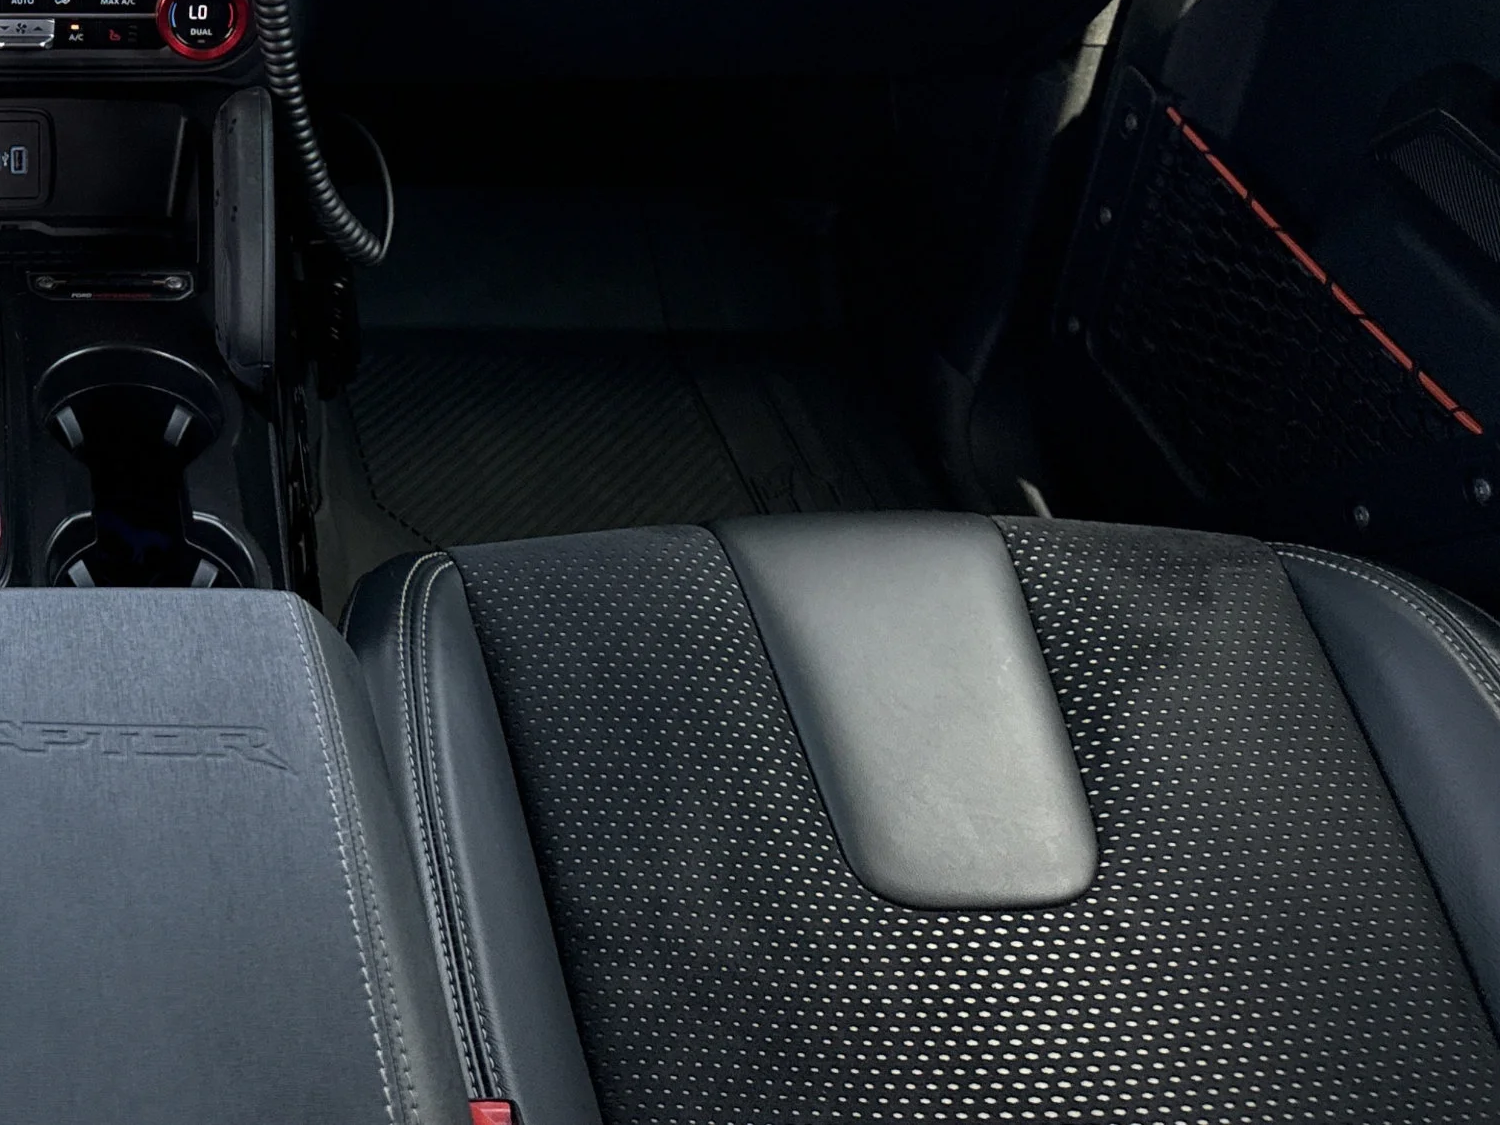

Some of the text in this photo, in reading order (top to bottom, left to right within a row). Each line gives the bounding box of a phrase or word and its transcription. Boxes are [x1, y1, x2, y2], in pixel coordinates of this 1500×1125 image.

[188, 4, 208, 20] LO
[190, 27, 213, 36] DUAL
[68, 32, 84, 43] A/C
